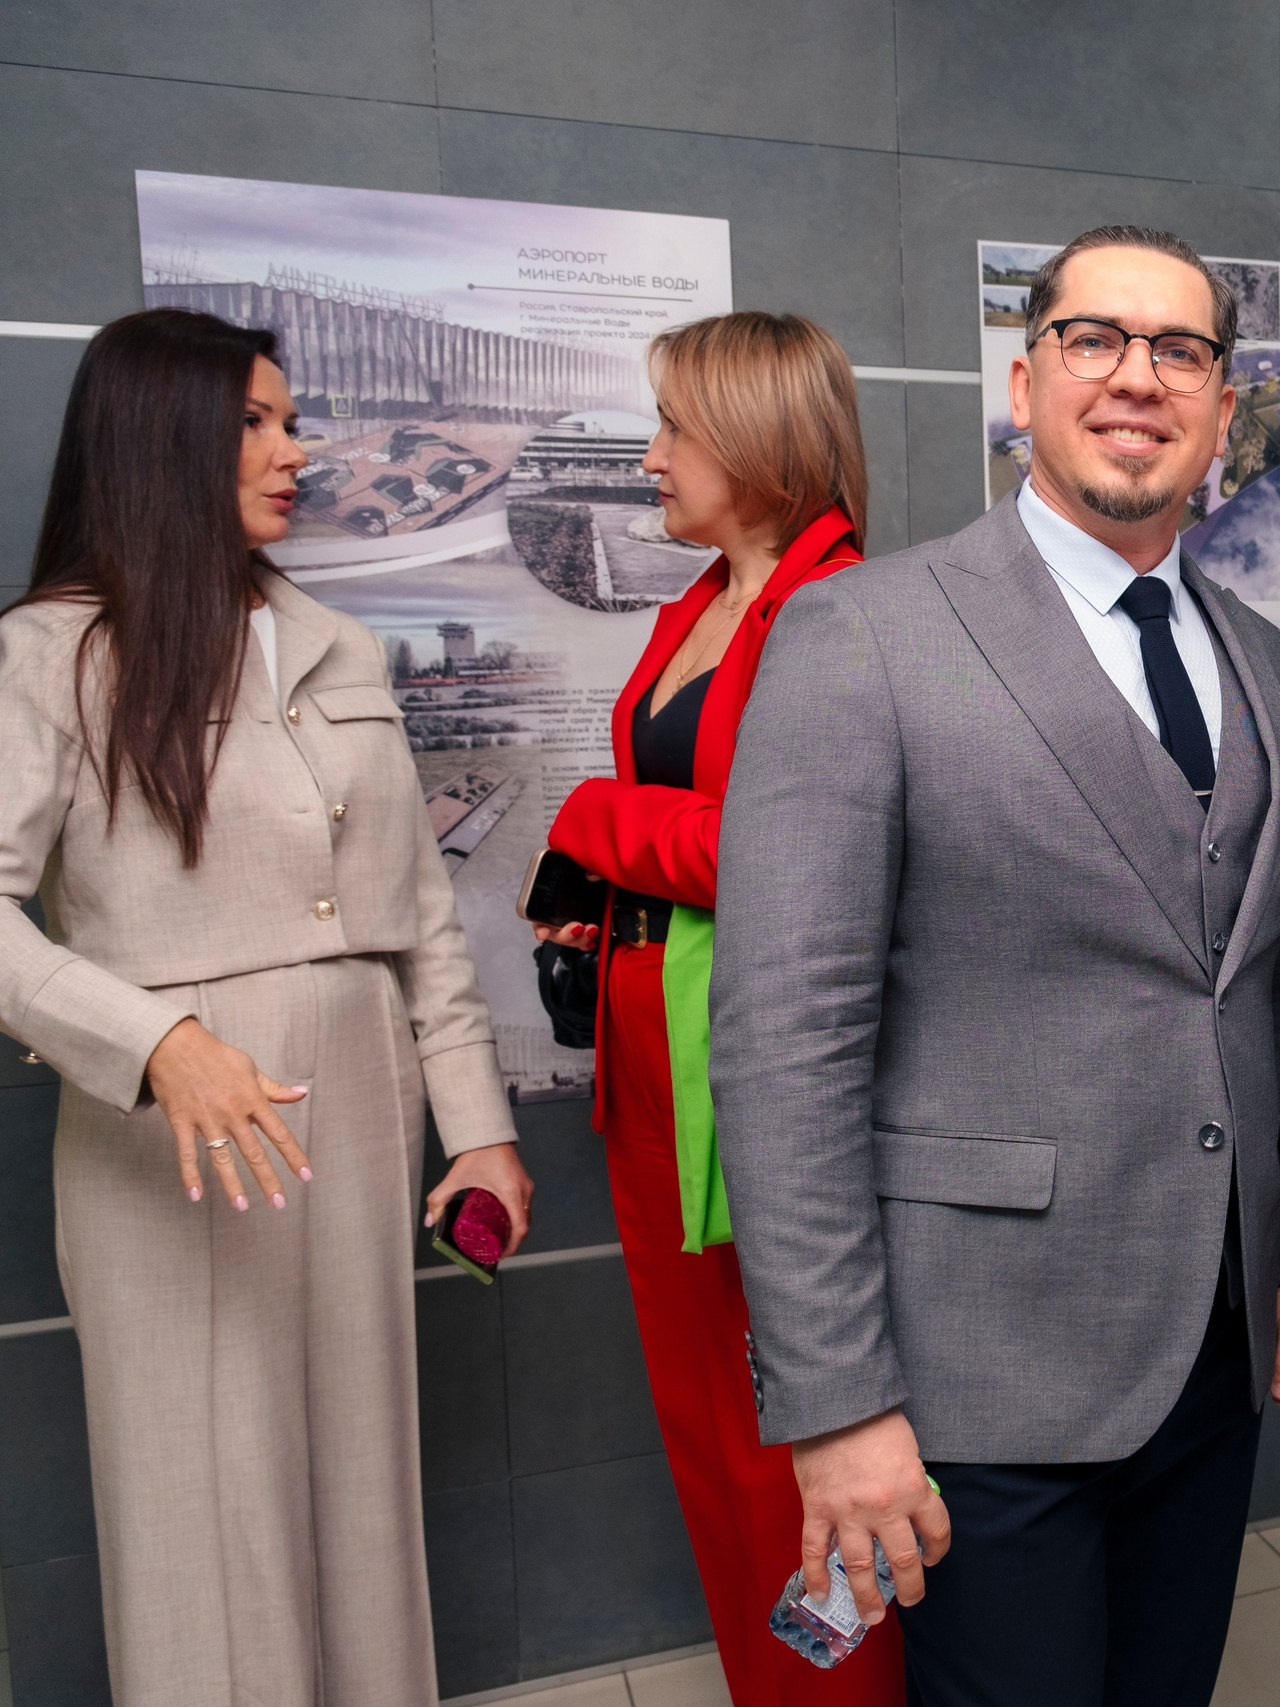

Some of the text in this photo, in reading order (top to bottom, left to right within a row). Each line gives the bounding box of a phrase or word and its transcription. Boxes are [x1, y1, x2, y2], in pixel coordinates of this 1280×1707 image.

[518, 248, 607, 264] АЭРОПОРТ
[518, 268, 698, 291] МИНЕРАЛЬНЫЕ ВОДЫ
[520, 302, 556, 312] Россия,
[560, 304, 642, 316] Ставропольский
[529, 315, 601, 325] Минеральные
[604, 319, 630, 327] Воды
[584, 330, 625, 339] проекта
